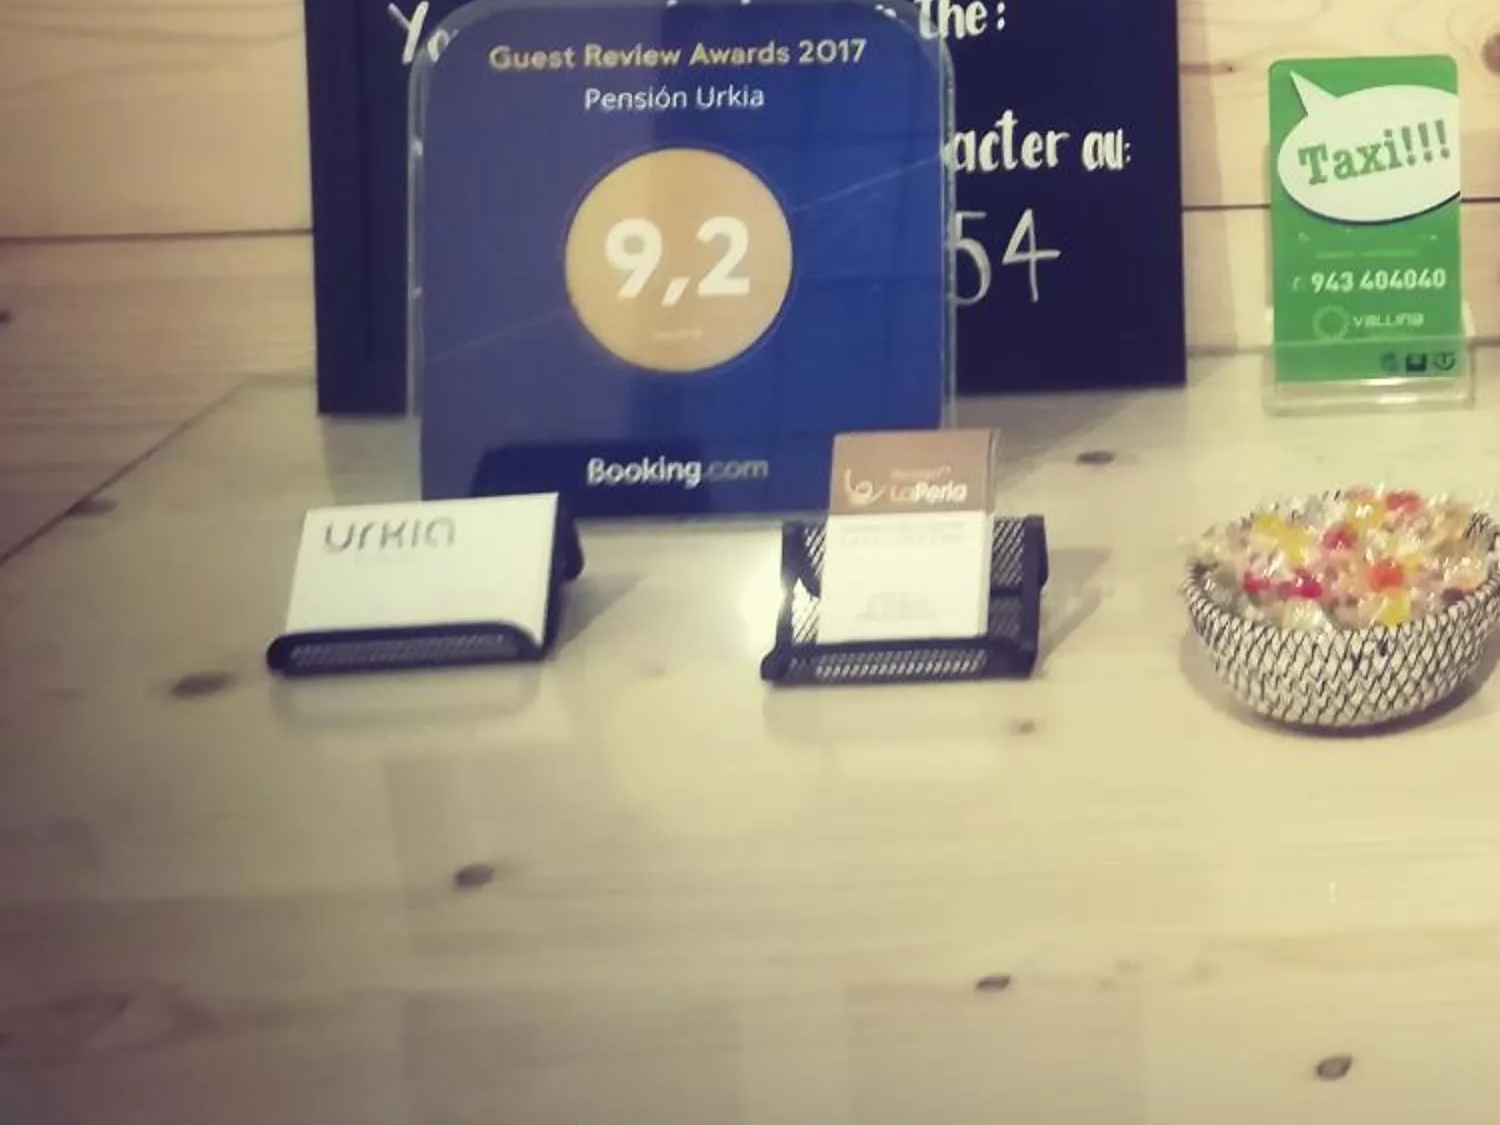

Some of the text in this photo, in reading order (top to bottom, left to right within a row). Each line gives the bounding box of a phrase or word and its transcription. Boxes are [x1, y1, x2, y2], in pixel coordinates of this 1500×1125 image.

[488, 38, 868, 70] Guest Review Awards 2017
[584, 83, 765, 111] Pensión Urkia
[944, 108, 1071, 173] acter
[1297, 118, 1450, 186] Taxi!!!
[604, 215, 752, 308] 9,2
[1311, 267, 1447, 294] 943 404040
[586, 455, 770, 489] Booking.com
